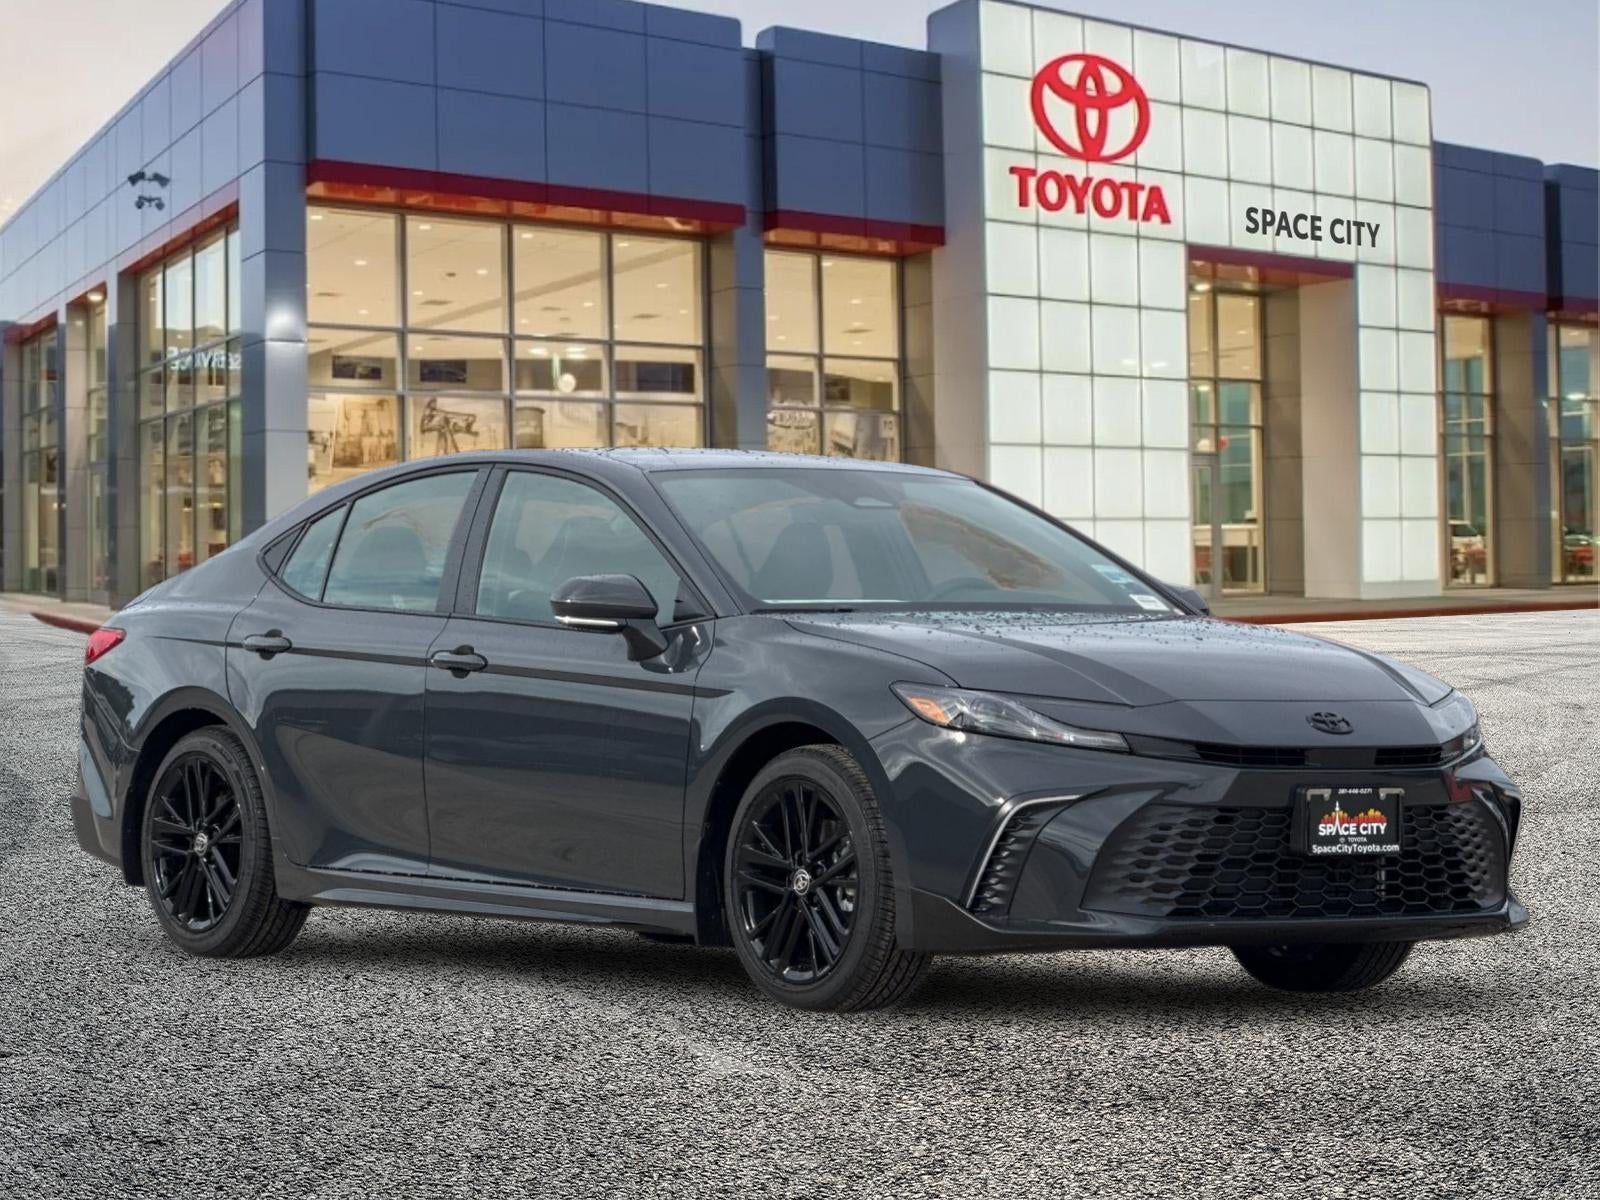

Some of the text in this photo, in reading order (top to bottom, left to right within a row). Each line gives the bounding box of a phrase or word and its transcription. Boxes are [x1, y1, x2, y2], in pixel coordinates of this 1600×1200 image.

[1010, 167, 1171, 224] TOYOTA
[1245, 207, 1380, 248] SPACE CITY
[1318, 815, 1387, 835] SPACE CITY
[1312, 844, 1400, 854] SpaceCityToyota.com
